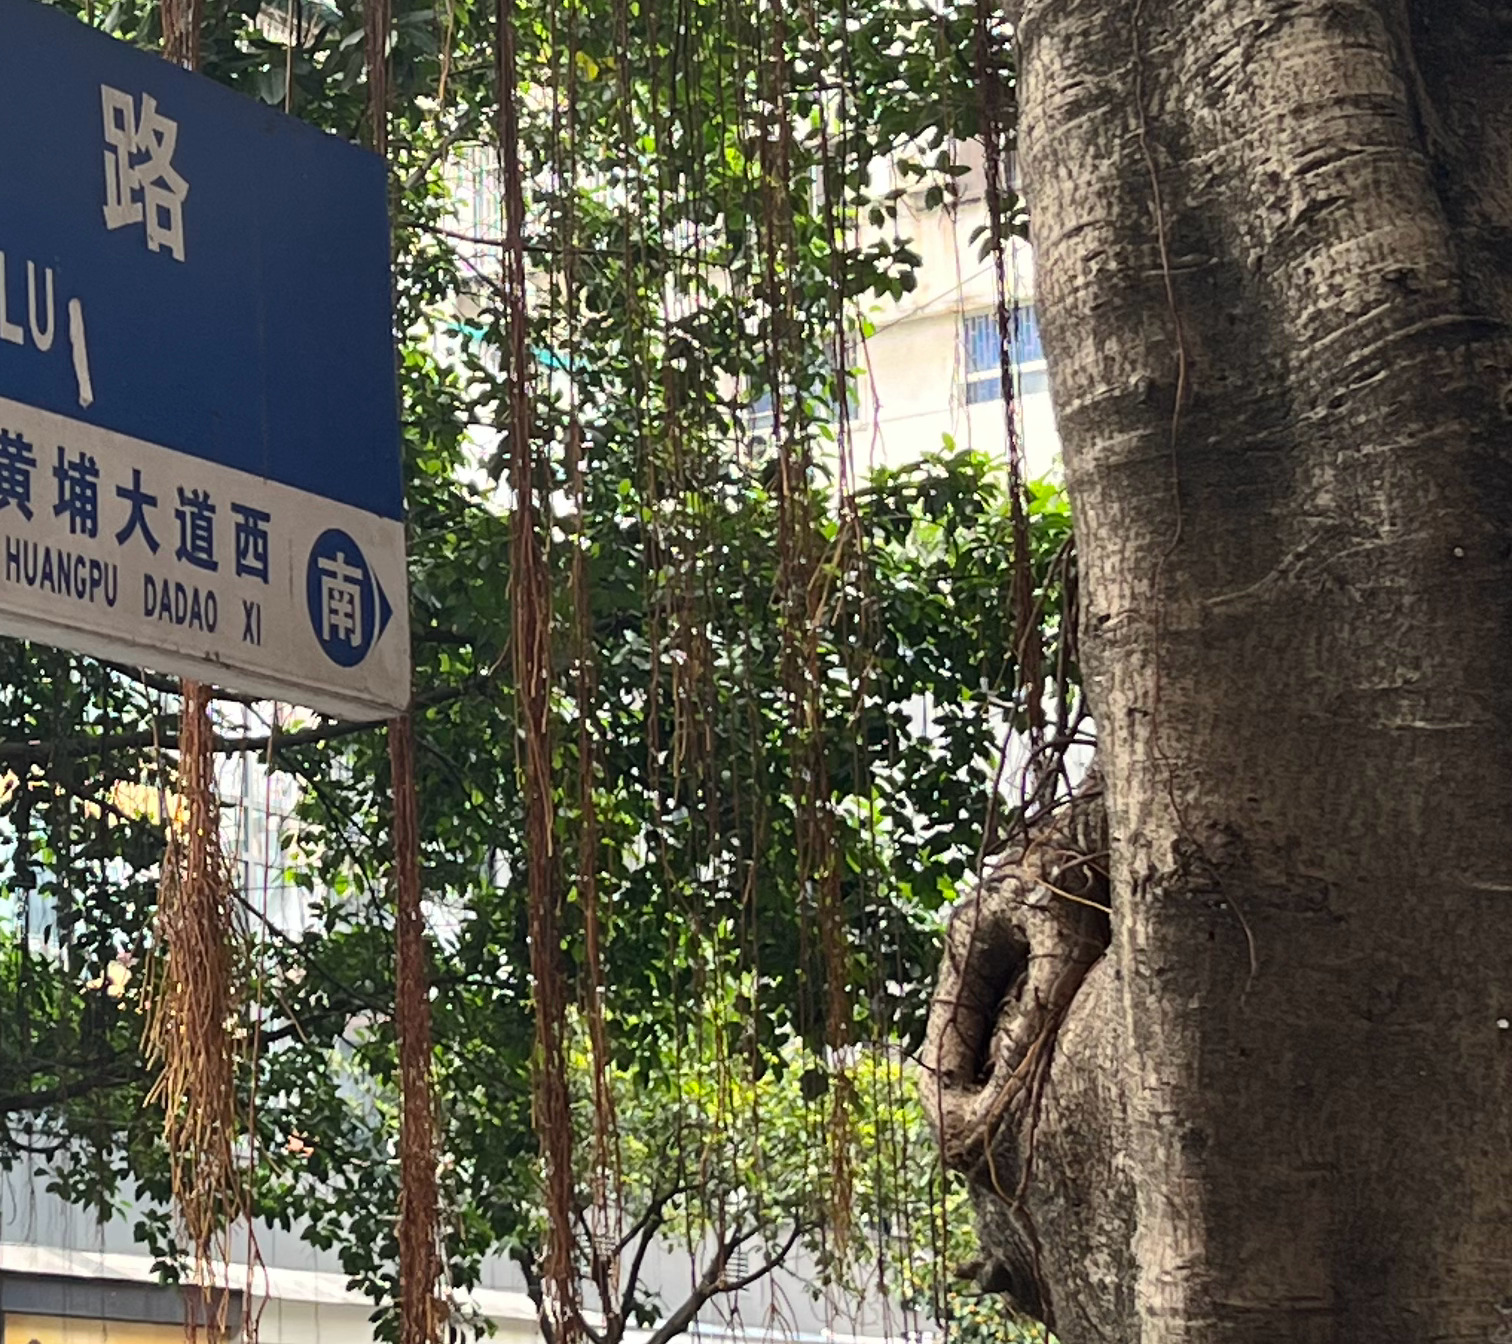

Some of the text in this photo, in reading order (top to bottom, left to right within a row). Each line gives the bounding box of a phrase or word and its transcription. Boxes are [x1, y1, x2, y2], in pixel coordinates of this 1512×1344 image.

[5, 535, 262, 648] HUANGPU DADAO XI
[316, 550, 365, 648] 南
